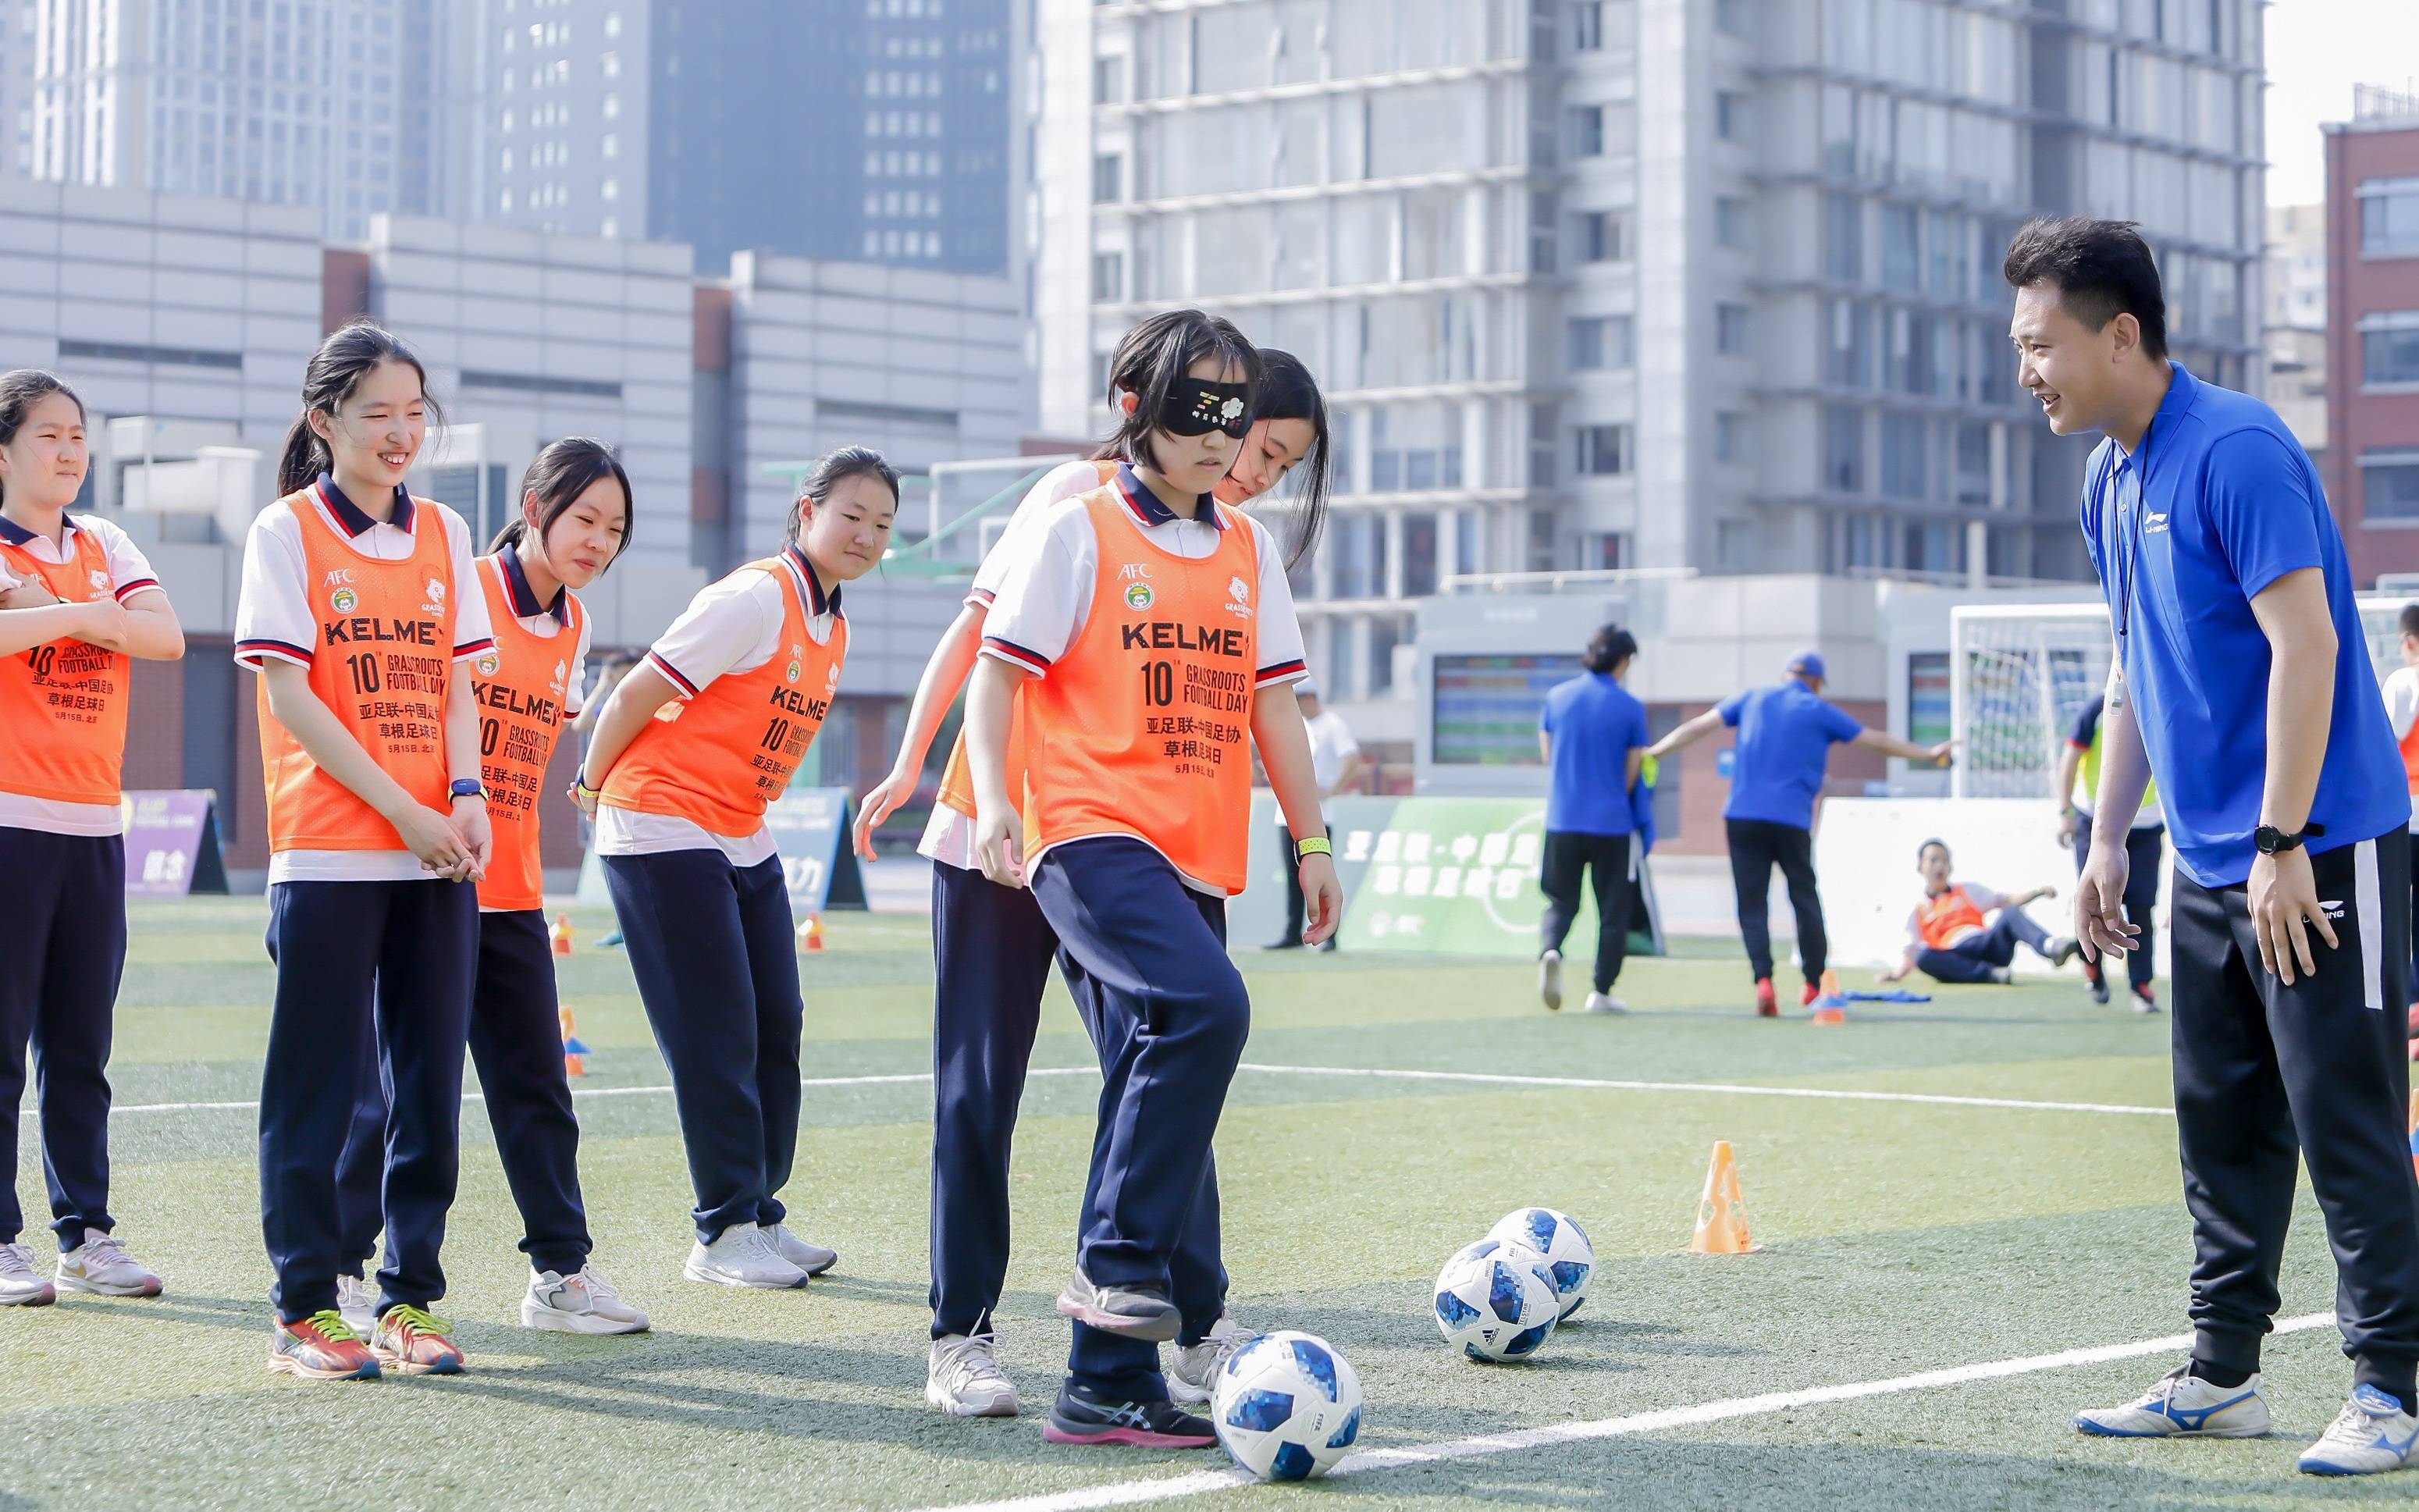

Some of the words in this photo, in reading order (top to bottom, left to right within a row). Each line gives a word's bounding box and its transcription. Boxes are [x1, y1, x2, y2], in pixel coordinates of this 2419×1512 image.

[324, 568, 355, 587] AFC
[1117, 563, 1153, 580] AFC
[325, 618, 436, 646] KELME
[1122, 622, 1243, 656] KELME
[58, 656, 107, 674] FOOTBALL
[387, 654, 443, 677] GRASSROOTS
[1186, 664, 1246, 692] GRASSROOTS
[47, 692, 105, 712] 草根足球日
[471, 681, 553, 724] KELME
[770, 686, 827, 722] KELME
[1183, 684, 1222, 710] FOOTBALL
[1226, 692, 1247, 713] DAY
[1488, 1328, 1500, 1346] adidas
